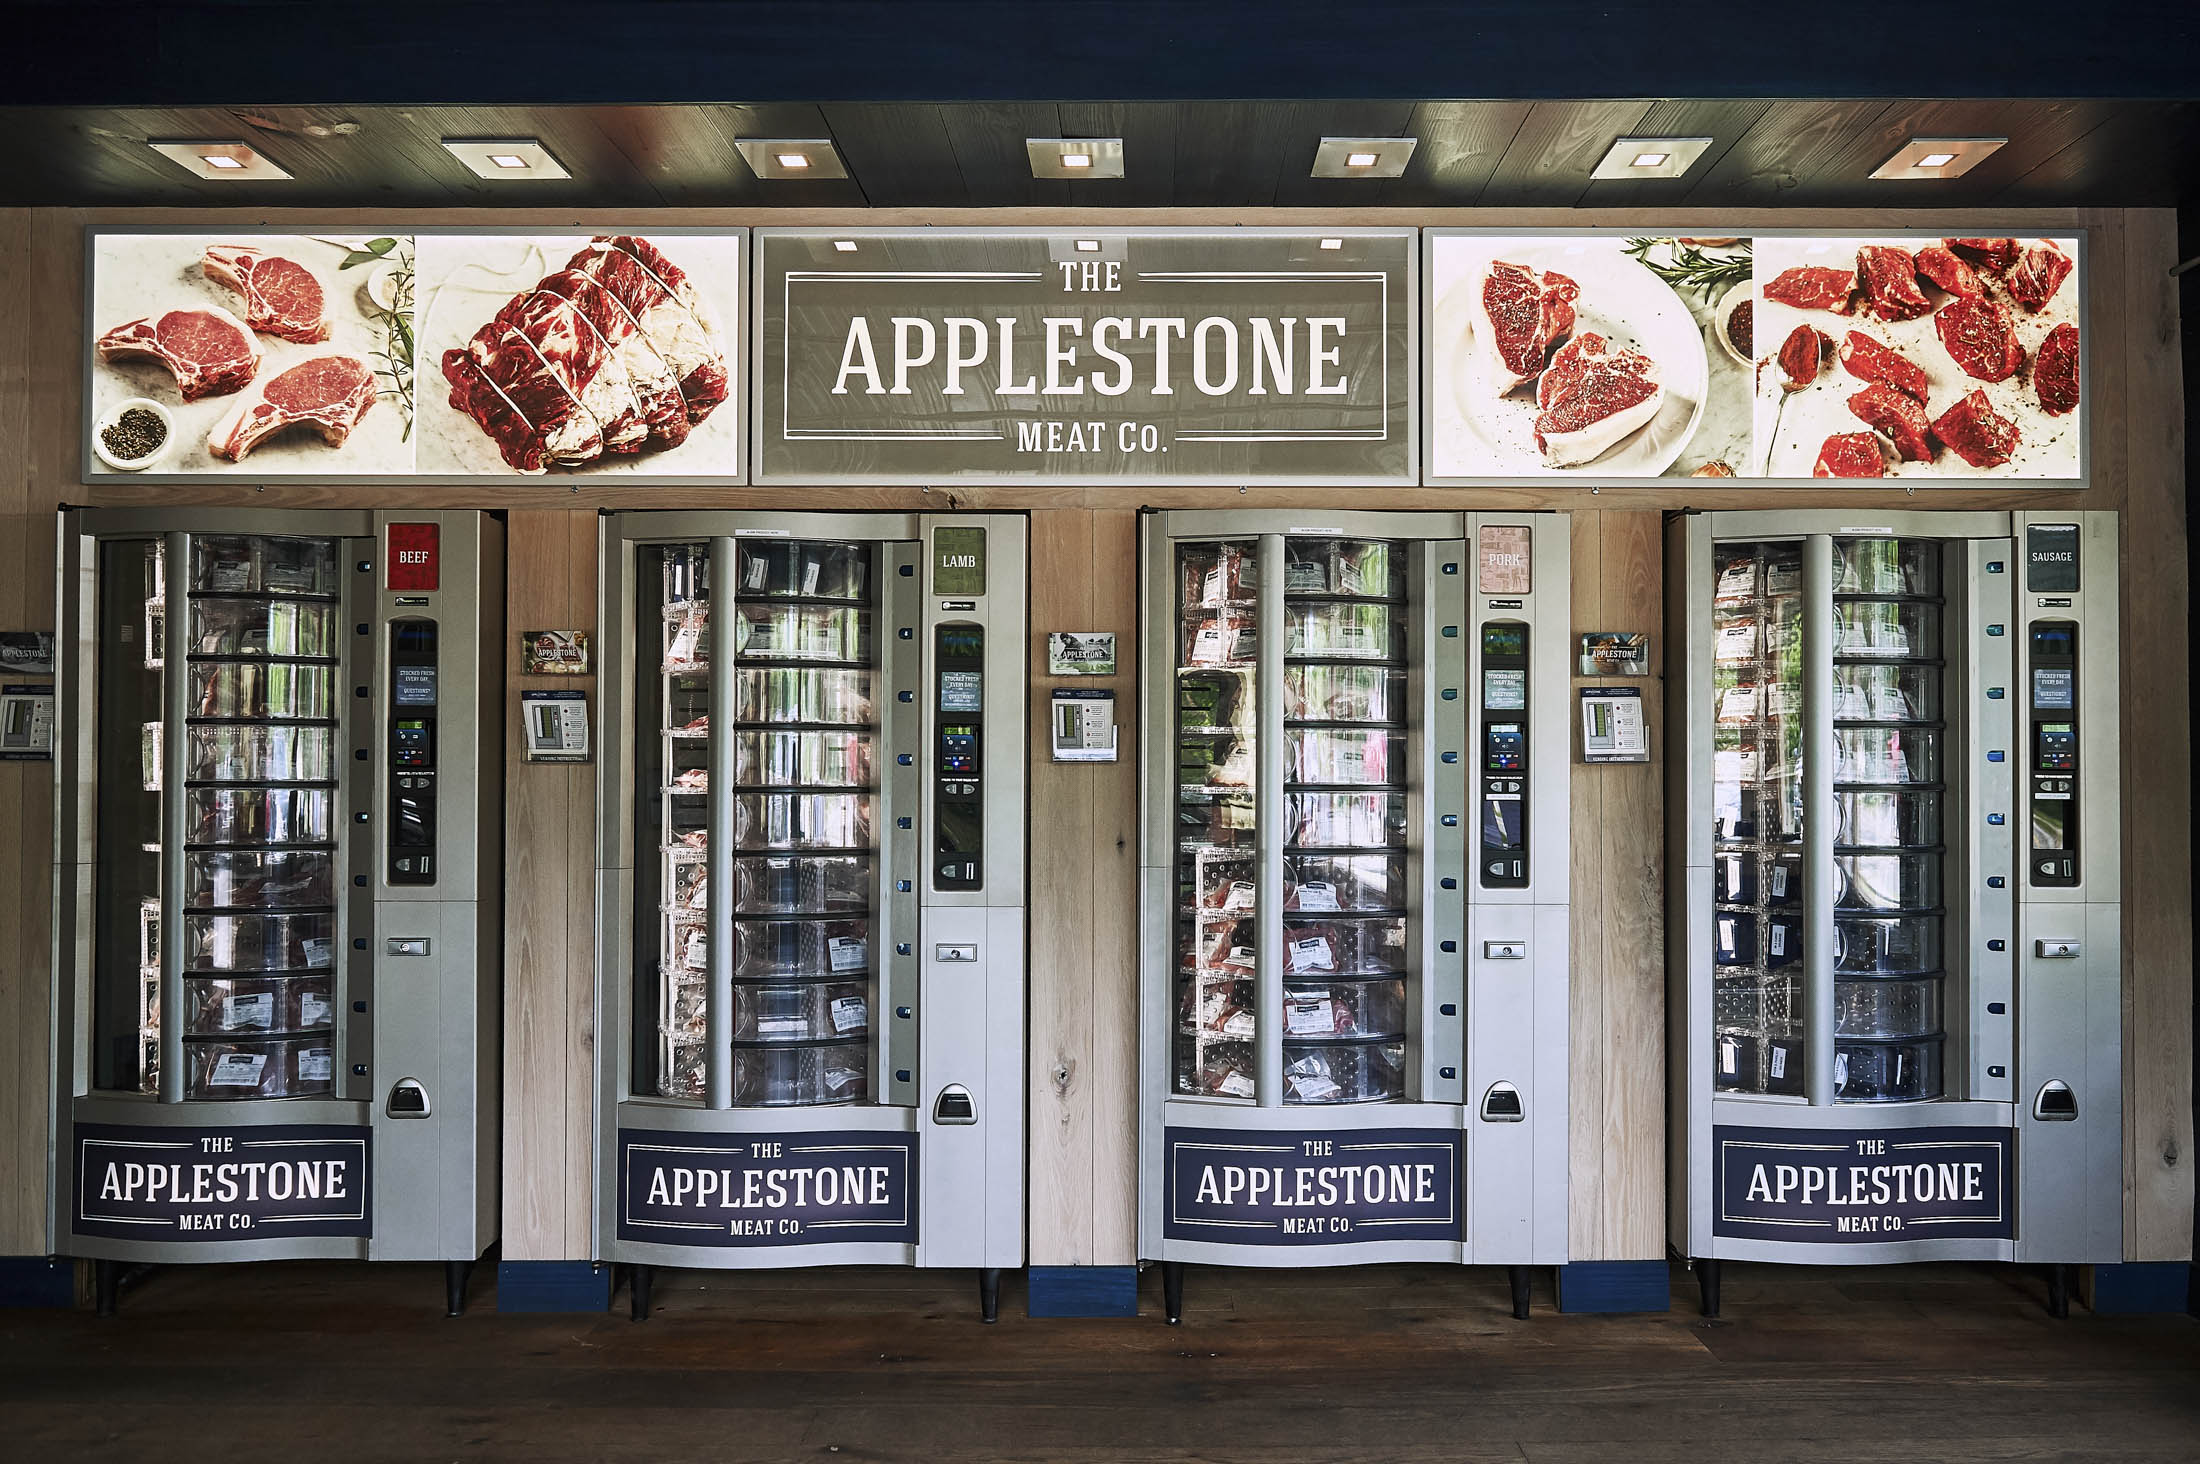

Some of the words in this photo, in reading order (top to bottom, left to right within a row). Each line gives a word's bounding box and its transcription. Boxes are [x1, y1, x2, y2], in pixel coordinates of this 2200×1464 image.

[1058, 261, 1121, 292] THE
[831, 316, 1348, 396] APPLESTONE
[1016, 422, 1106, 452] MEAT
[399, 550, 429, 564] BEEF
[943, 555, 976, 568] LAMB
[1488, 554, 1521, 566] PORK
[2032, 552, 2073, 562] SAUSAGE
[538, 648, 577, 657] APPLESTONE
[1062, 650, 1104, 659] APPLESTONE
[1591, 649, 1637, 658] APPLESTONE
[201, 1137, 233, 1153] THE
[751, 1143, 782, 1159] THE
[1303, 1141, 1333, 1157] THE
[1857, 1139, 1886, 1156] THE
[100, 1160, 347, 1203] APPLESTONE
[646, 1166, 890, 1209] APPLESTONE
[1195, 1164, 1435, 1207] APPLESTONE
[1745, 1162, 1983, 1205] APPLESTONE
[179, 1213, 225, 1231] MEAT
[730, 1219, 774, 1236] MEAT
[1283, 1217, 1326, 1234] MEAT
[1837, 1216, 1879, 1233] MEAT
